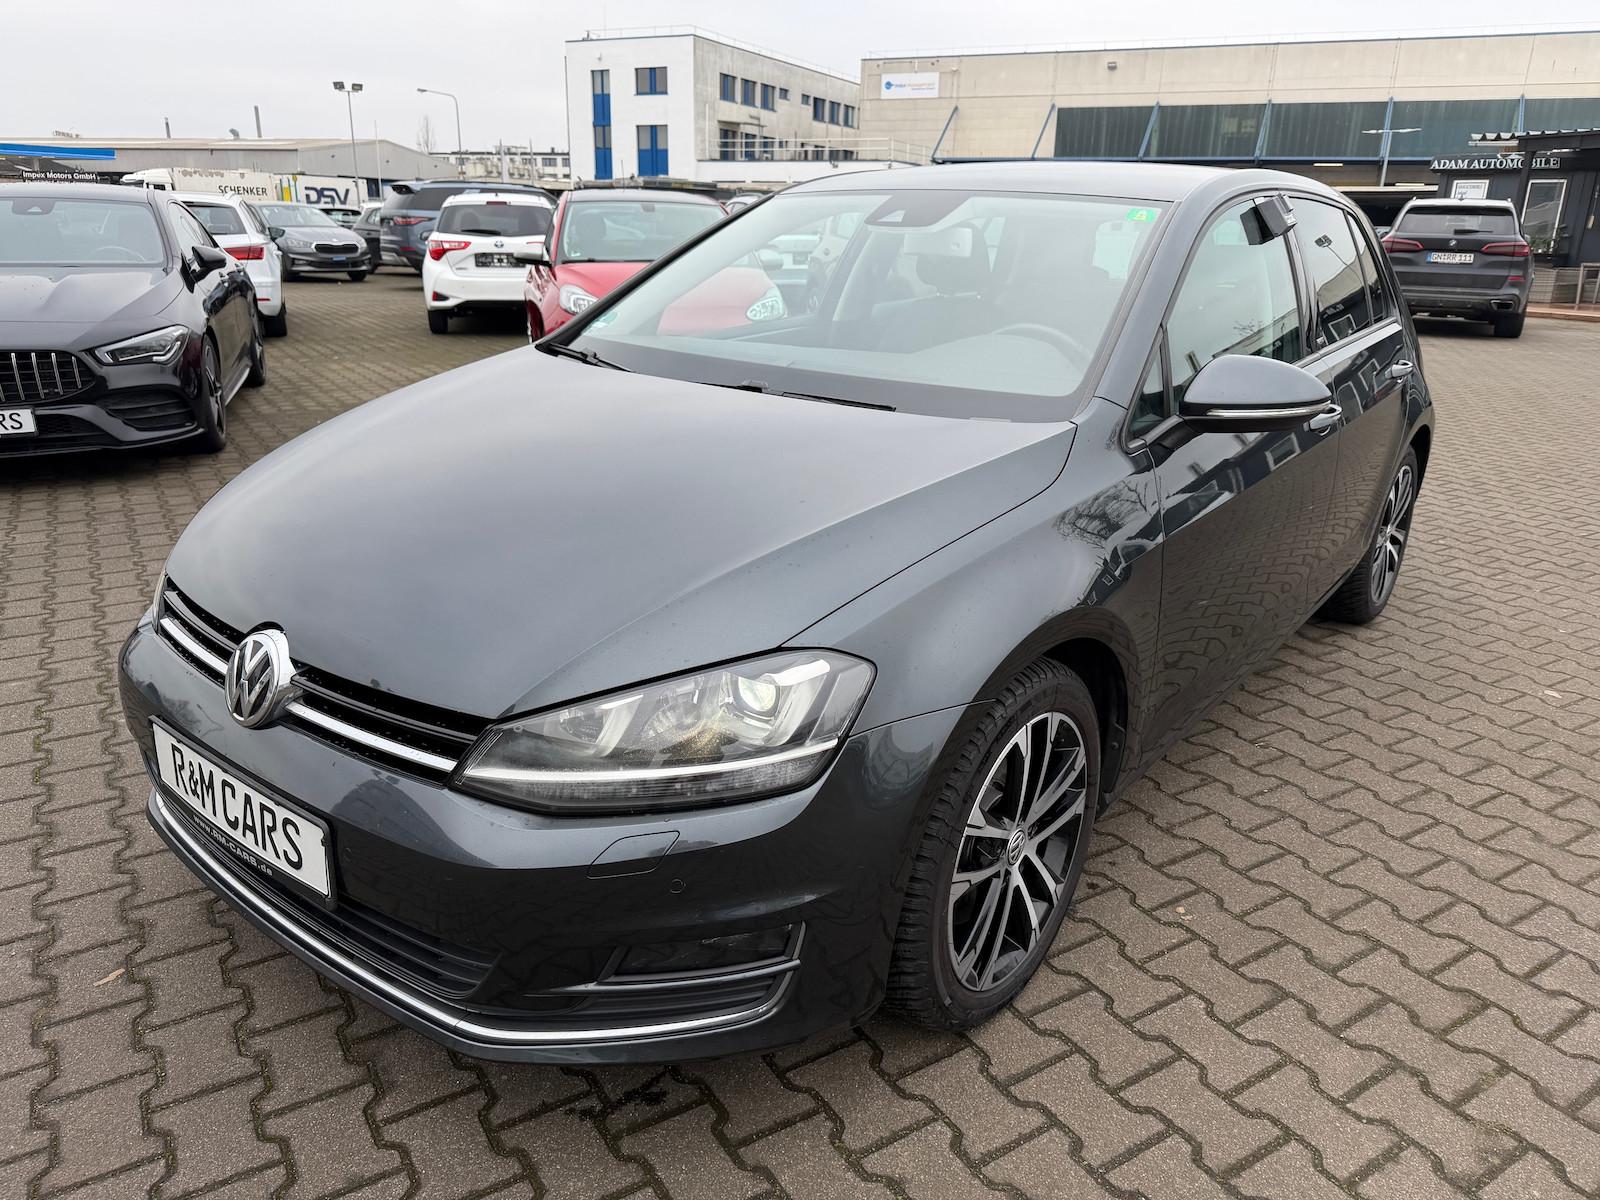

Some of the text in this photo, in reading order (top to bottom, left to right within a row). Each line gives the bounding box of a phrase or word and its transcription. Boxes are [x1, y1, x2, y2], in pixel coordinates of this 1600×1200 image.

[1430, 158, 1470, 170] ADAM
[46, 171, 72, 180] Motors
[218, 184, 268, 197] SCHENKER
[304, 186, 350, 205] DSV
[171, 742, 303, 871] R&M CARS
[192, 814, 273, 876] www.RM-CARS.de
